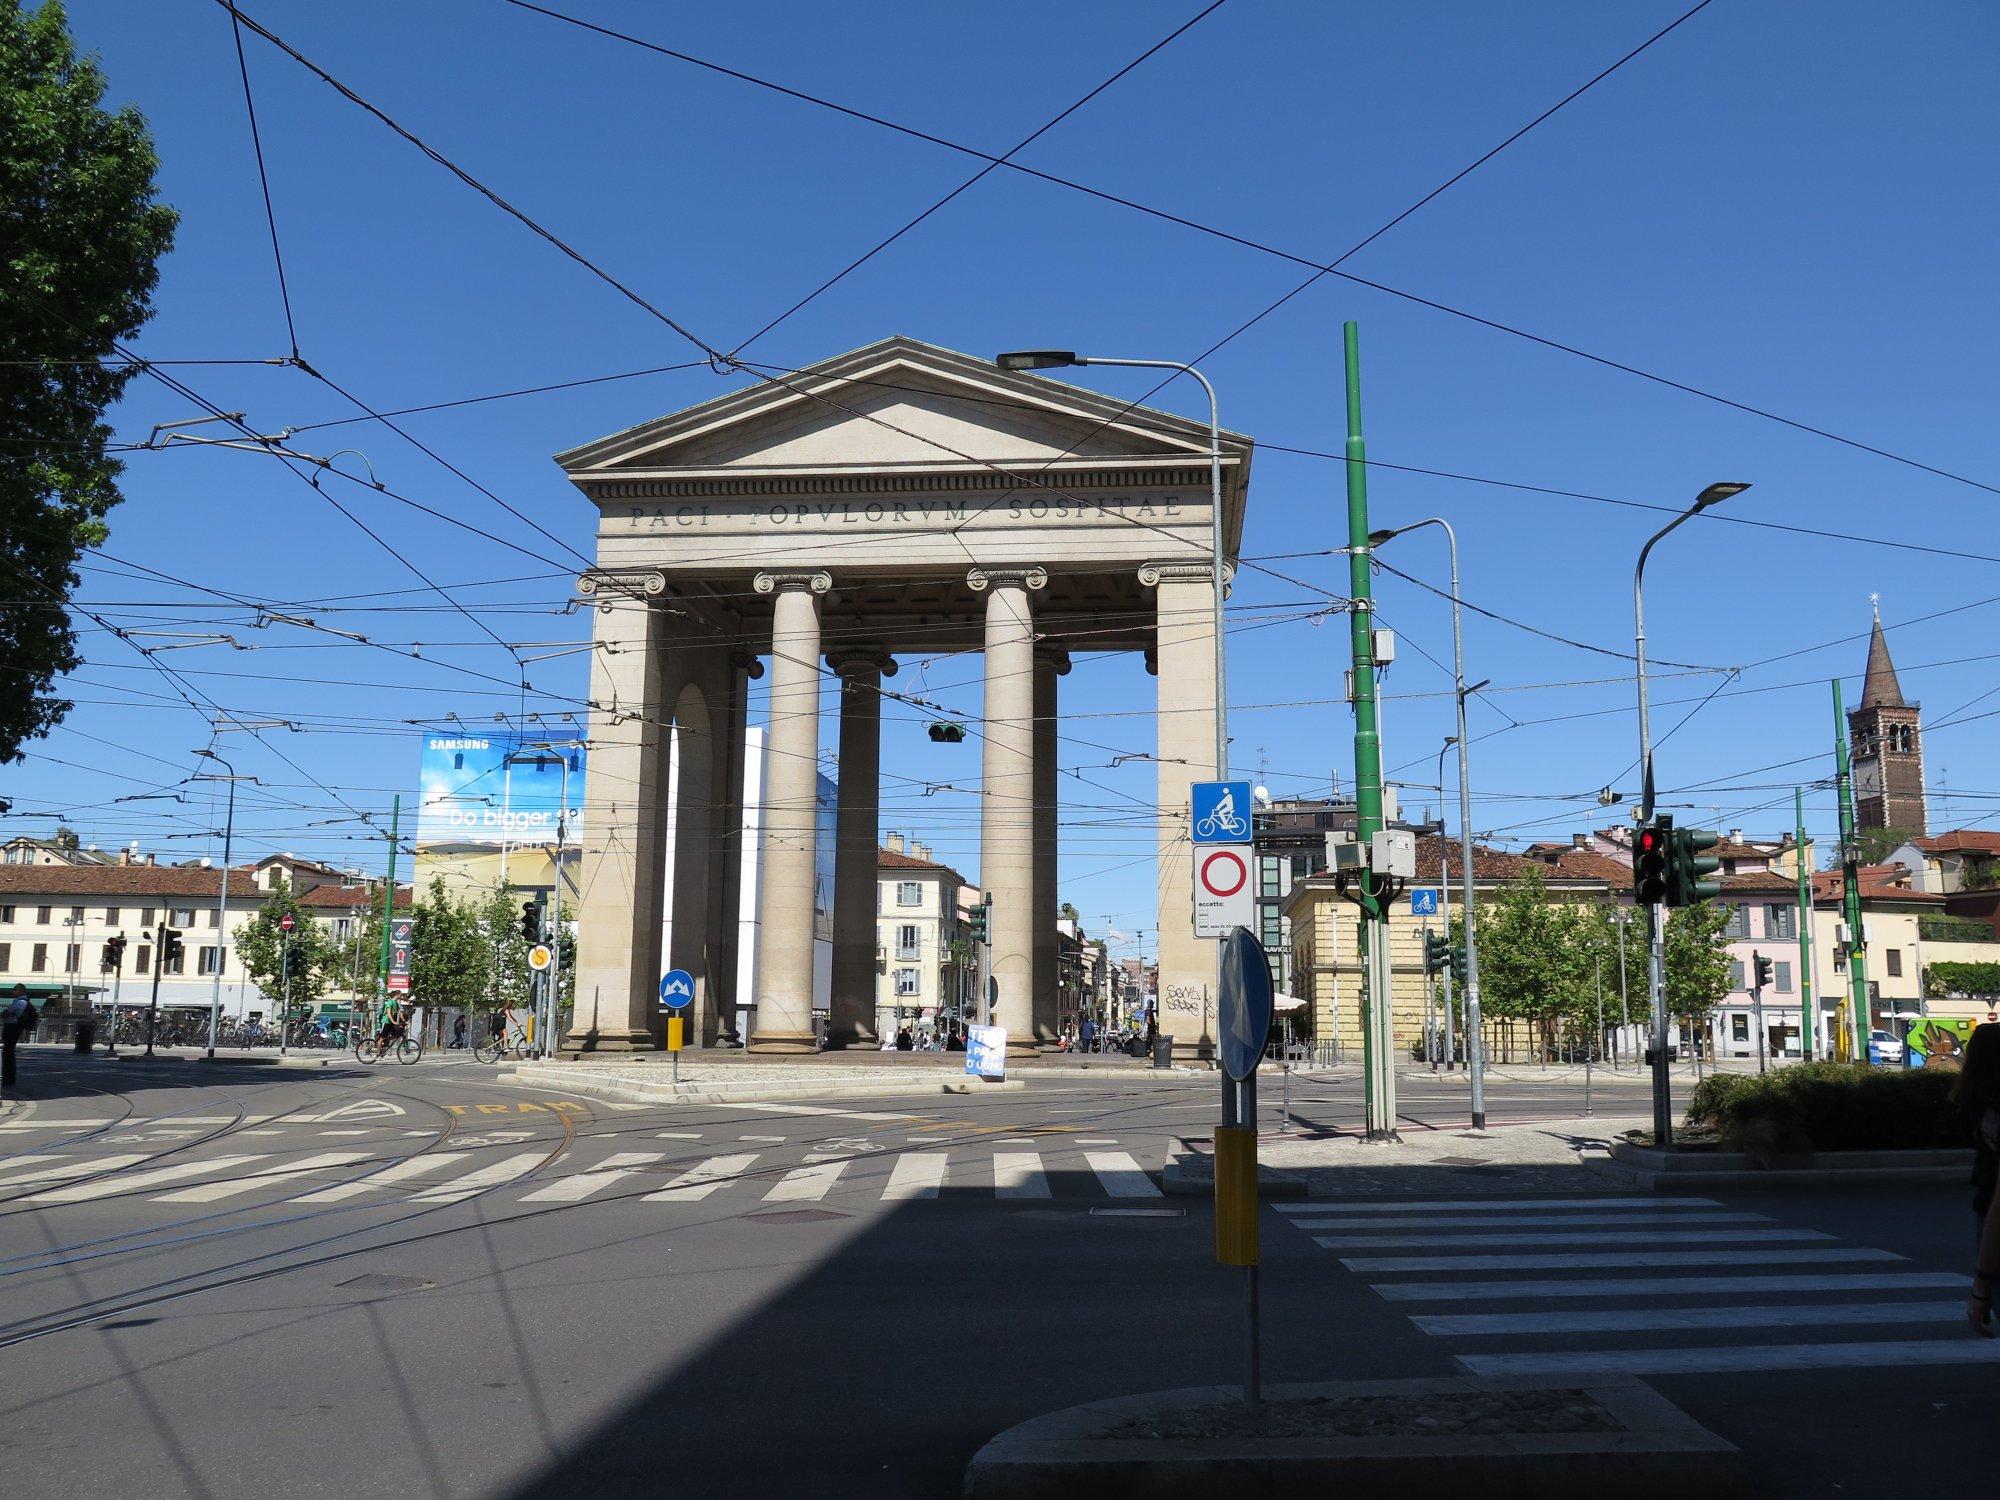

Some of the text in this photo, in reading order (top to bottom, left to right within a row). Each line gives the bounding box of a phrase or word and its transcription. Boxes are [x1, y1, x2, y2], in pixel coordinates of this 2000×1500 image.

[629, 496, 1182, 527] PACI POPVLORVM SOSPITAE
[429, 739, 489, 750] SAMSUNG
[450, 809, 477, 826] Do
[484, 809, 552, 830] bigger
[441, 1101, 587, 1115] TRAM
